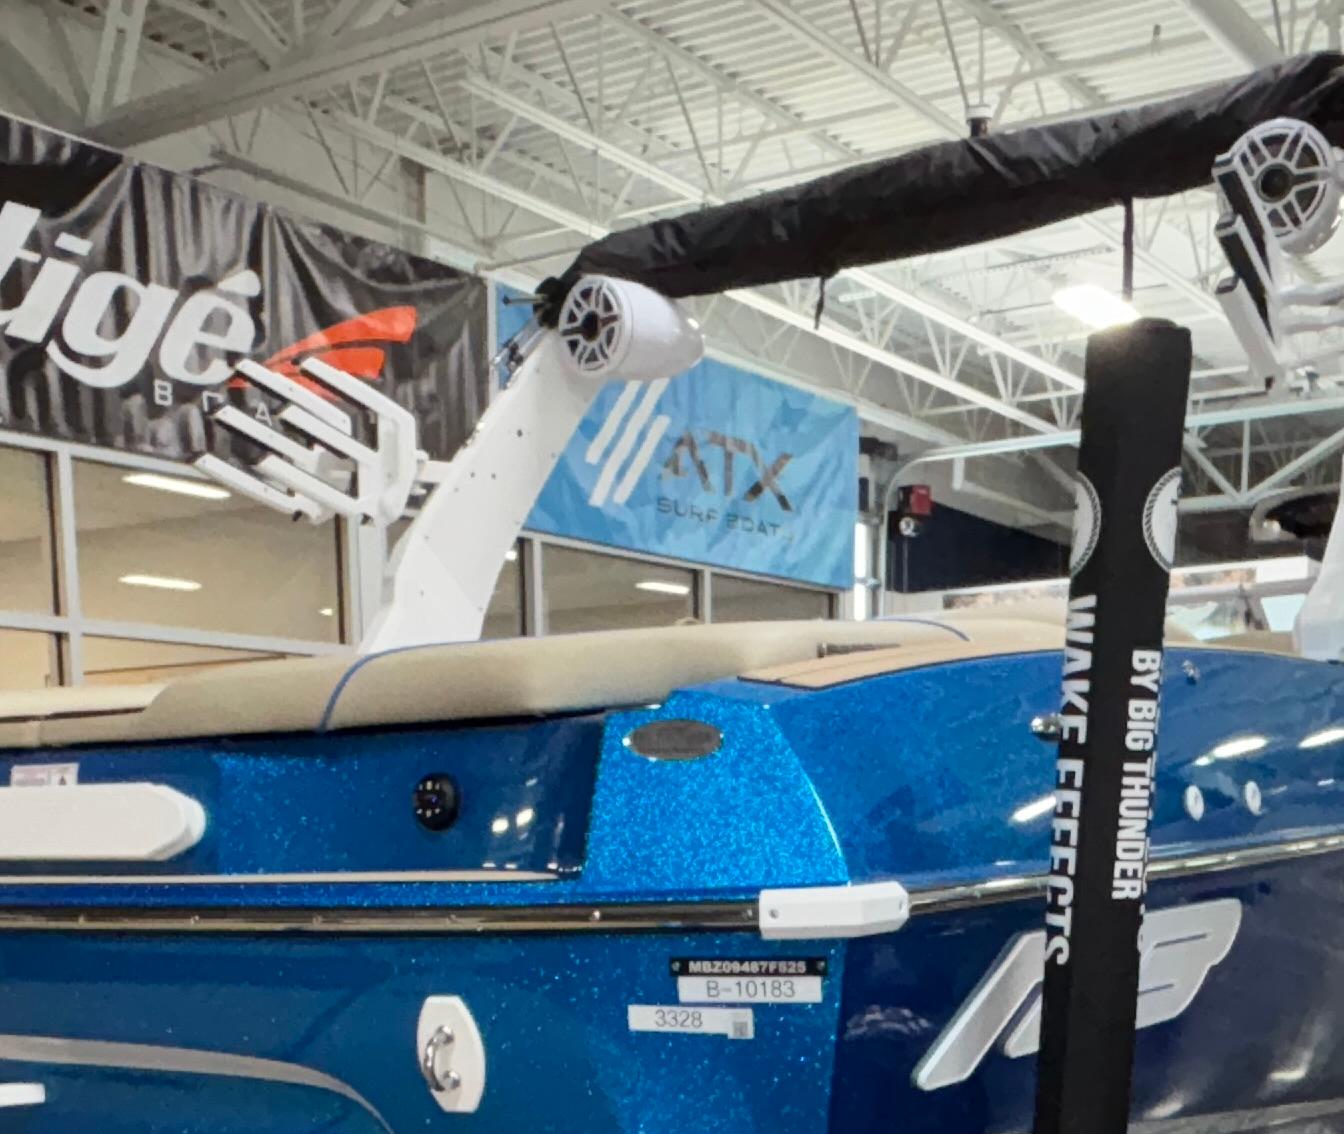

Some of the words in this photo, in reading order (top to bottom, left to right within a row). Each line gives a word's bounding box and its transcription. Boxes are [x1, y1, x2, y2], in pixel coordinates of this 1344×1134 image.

[661, 430, 794, 512] ATX
[656, 496, 719, 522] SURF
[1059, 594, 1098, 744] WAKE
[1131, 650, 1162, 692] BY
[1125, 699, 1159, 751] BIG
[1111, 757, 1153, 900] THUNDER
[1045, 758, 1085, 966] EFFECTS
[706, 980, 796, 999] B-10183
[654, 1009, 704, 1029] 3328
